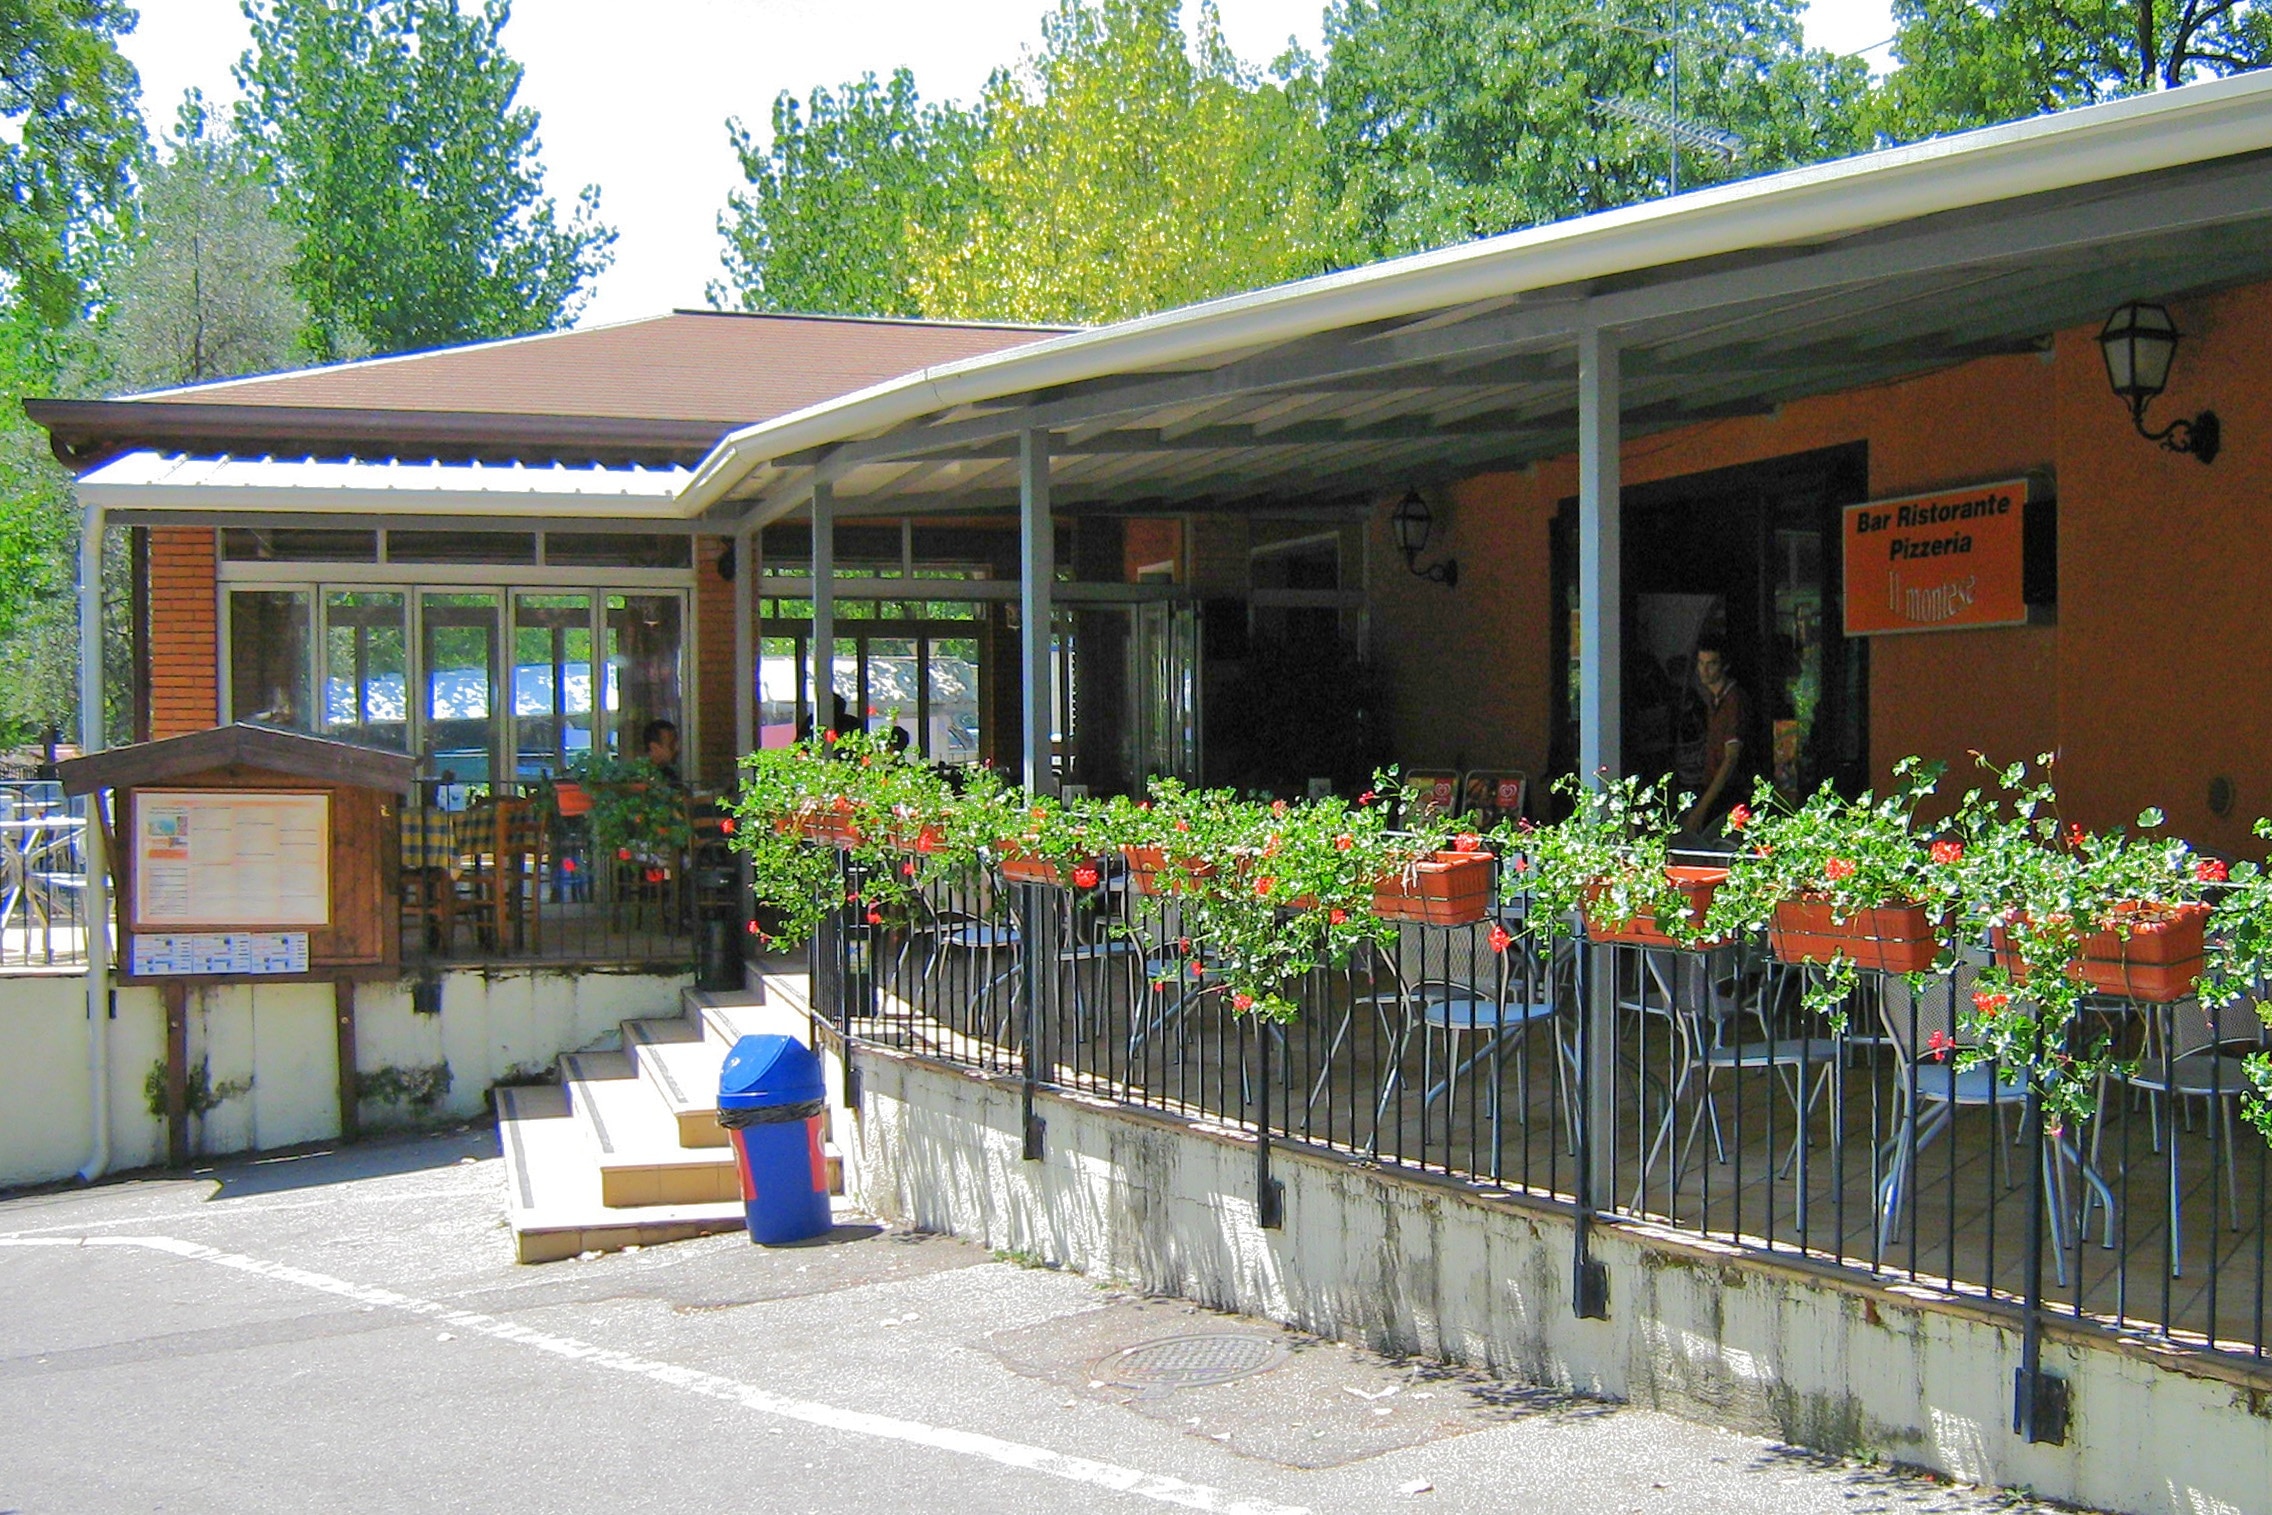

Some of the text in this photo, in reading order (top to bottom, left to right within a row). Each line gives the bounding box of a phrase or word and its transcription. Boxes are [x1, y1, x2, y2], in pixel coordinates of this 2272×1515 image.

[1857, 495, 2010, 533] Bar Ristorante
[1890, 532, 1972, 560] Pizzeria
